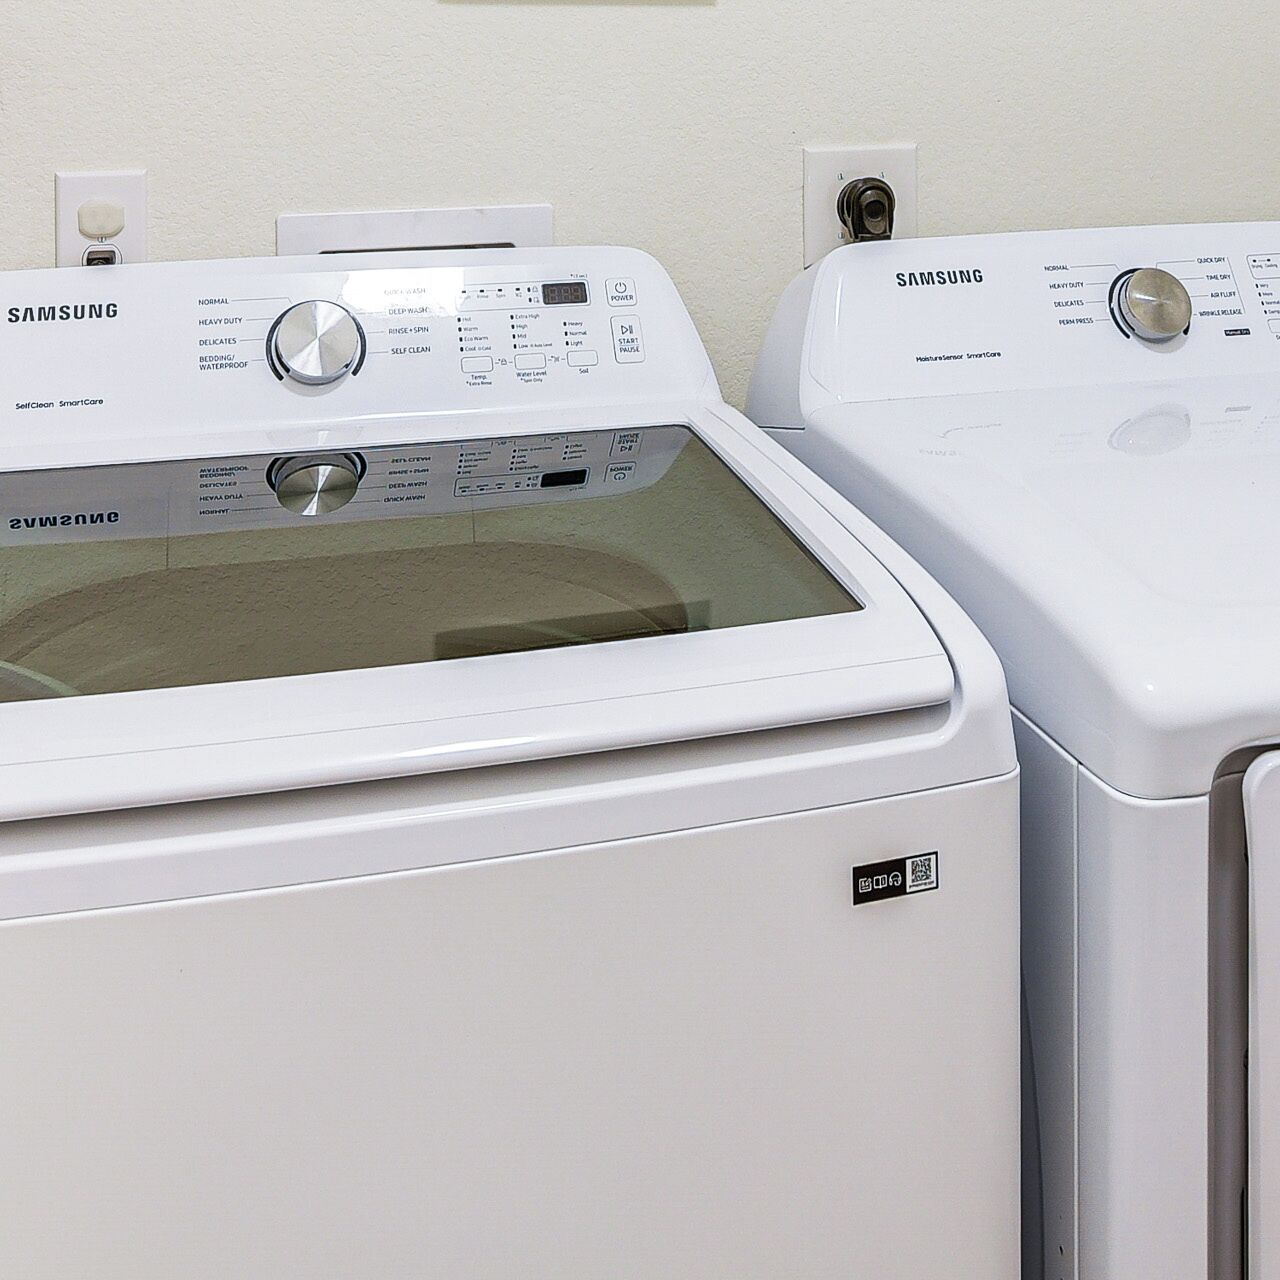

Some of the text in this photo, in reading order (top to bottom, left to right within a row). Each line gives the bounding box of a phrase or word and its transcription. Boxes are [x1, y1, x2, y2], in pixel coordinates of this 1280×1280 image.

[896, 268, 983, 287] SAMSUNG
[7, 303, 118, 323] SAMSUNG
[199, 338, 237, 346] DELICATES
[408, 346, 431, 354] CLEAN
[199, 354, 235, 362] BEDDING/
[199, 361, 248, 370] WATERPROOF
[15, 399, 104, 410] SelfClean SmartCare
